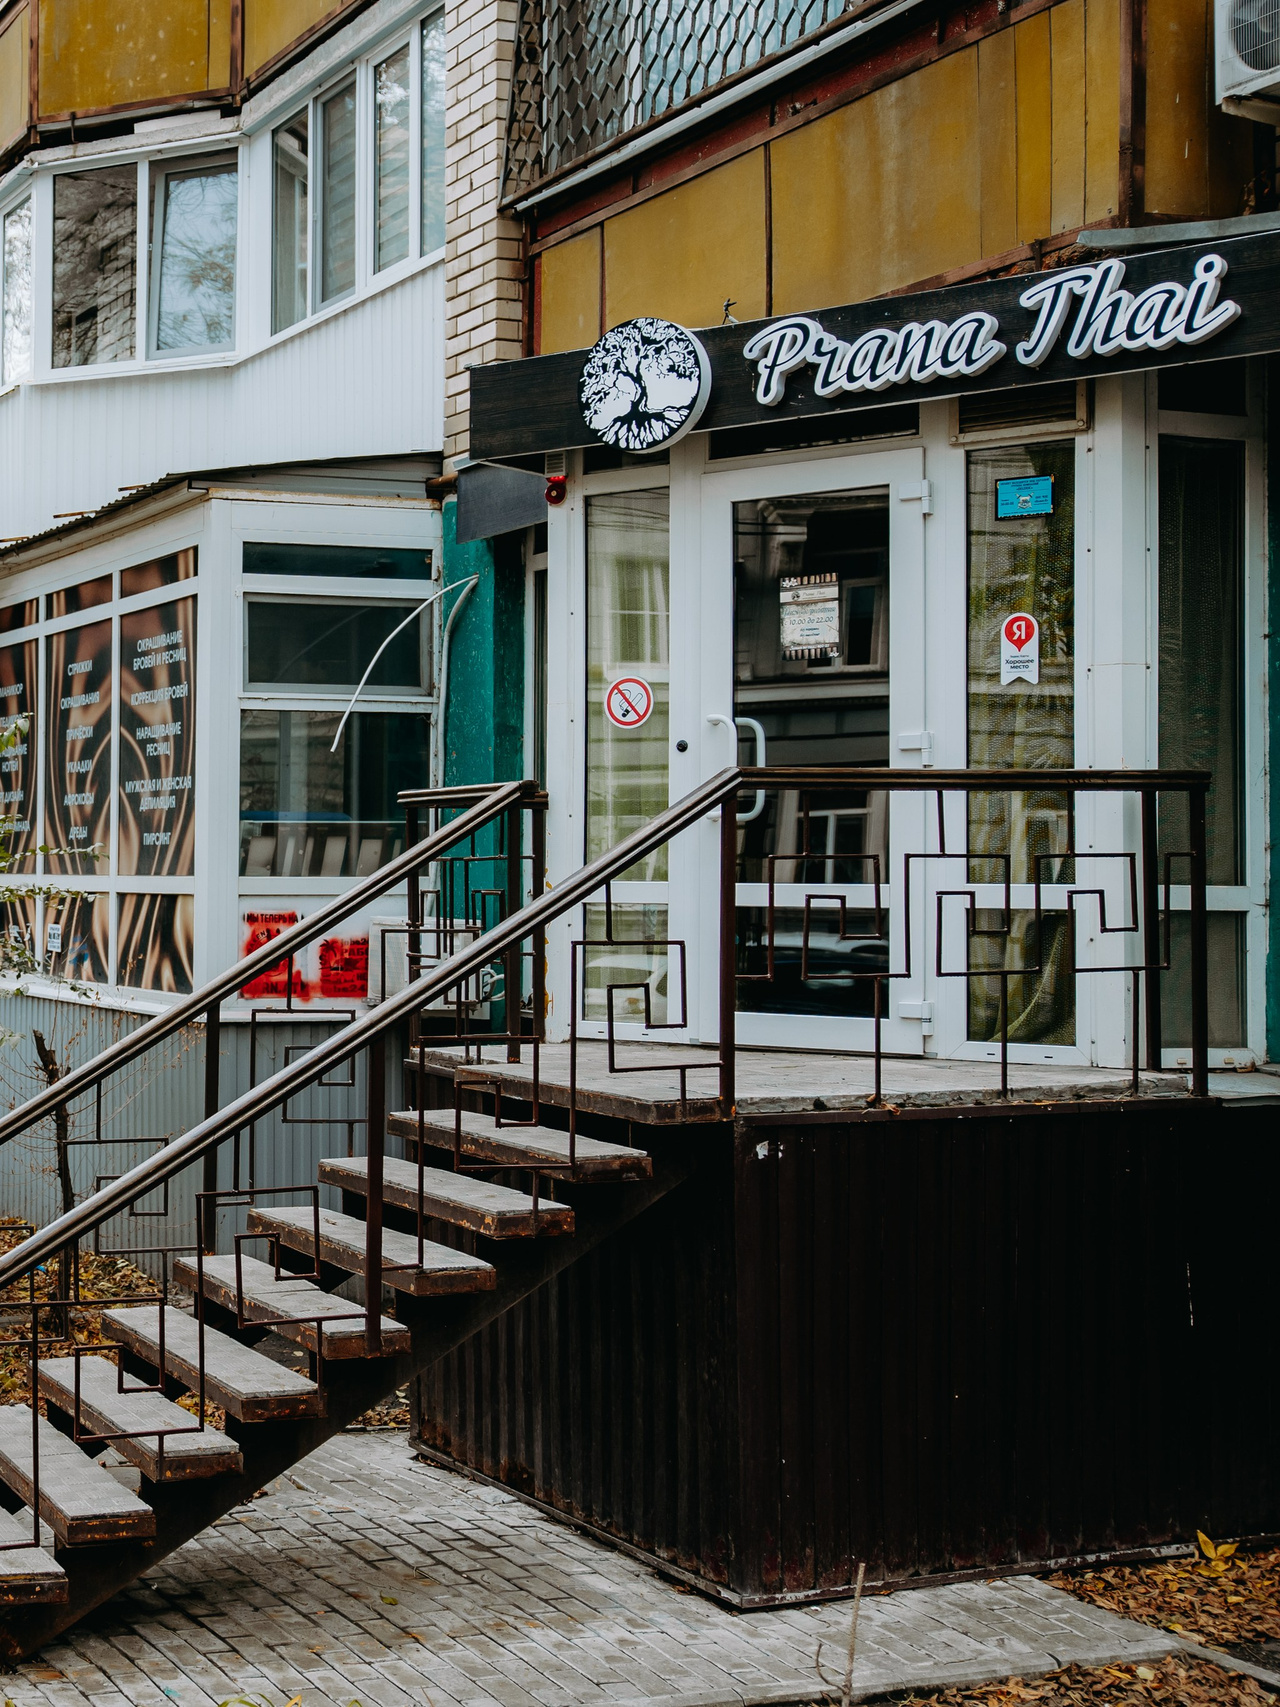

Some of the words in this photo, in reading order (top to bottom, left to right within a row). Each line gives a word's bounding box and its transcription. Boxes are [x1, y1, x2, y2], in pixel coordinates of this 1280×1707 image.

[743, 312, 1007, 407] Prana
[1015, 254, 1242, 369] Thai
[789, 618, 806, 626] 10.00
[816, 615, 834, 624] 22.00
[1012, 621, 1026, 640] Я
[137, 630, 183, 652] ОКРАШИВАНИЕ
[133, 652, 156, 671] БРОВЕЙ
[156, 653, 162, 666] И
[162, 647, 187, 664] РЕСНИЦ
[67, 660, 93, 676] СТРИЖКИ
[0, 683, 23, 698] МАНИКЮР
[130, 688, 165, 706] КОРРЕКЦИЯ
[165, 681, 188, 699] БРОВЕЙ
[60, 691, 100, 710] ОКРАШИВАНИЯ
[136, 722, 182, 740] НАРАЩИВАНИЕ
[146, 742, 171, 757] РЕСНИЦ
[67, 759, 93, 774] УКЛАДКИ
[125, 780, 155, 794] МУЖСКАЯ
[156, 779, 162, 791] И
[162, 775, 192, 791] ЖЕНСКАЯ
[139, 795, 176, 812] ДЕПИЛЯЦИЯ
[69, 826, 88, 840] ДРЕДЫ
[143, 832, 171, 846] ПИРСИНГ
[247, 913, 259, 923] МЫ
[260, 913, 287, 923] ТЕПЕРЬ
[288, 913, 299, 923] НА
